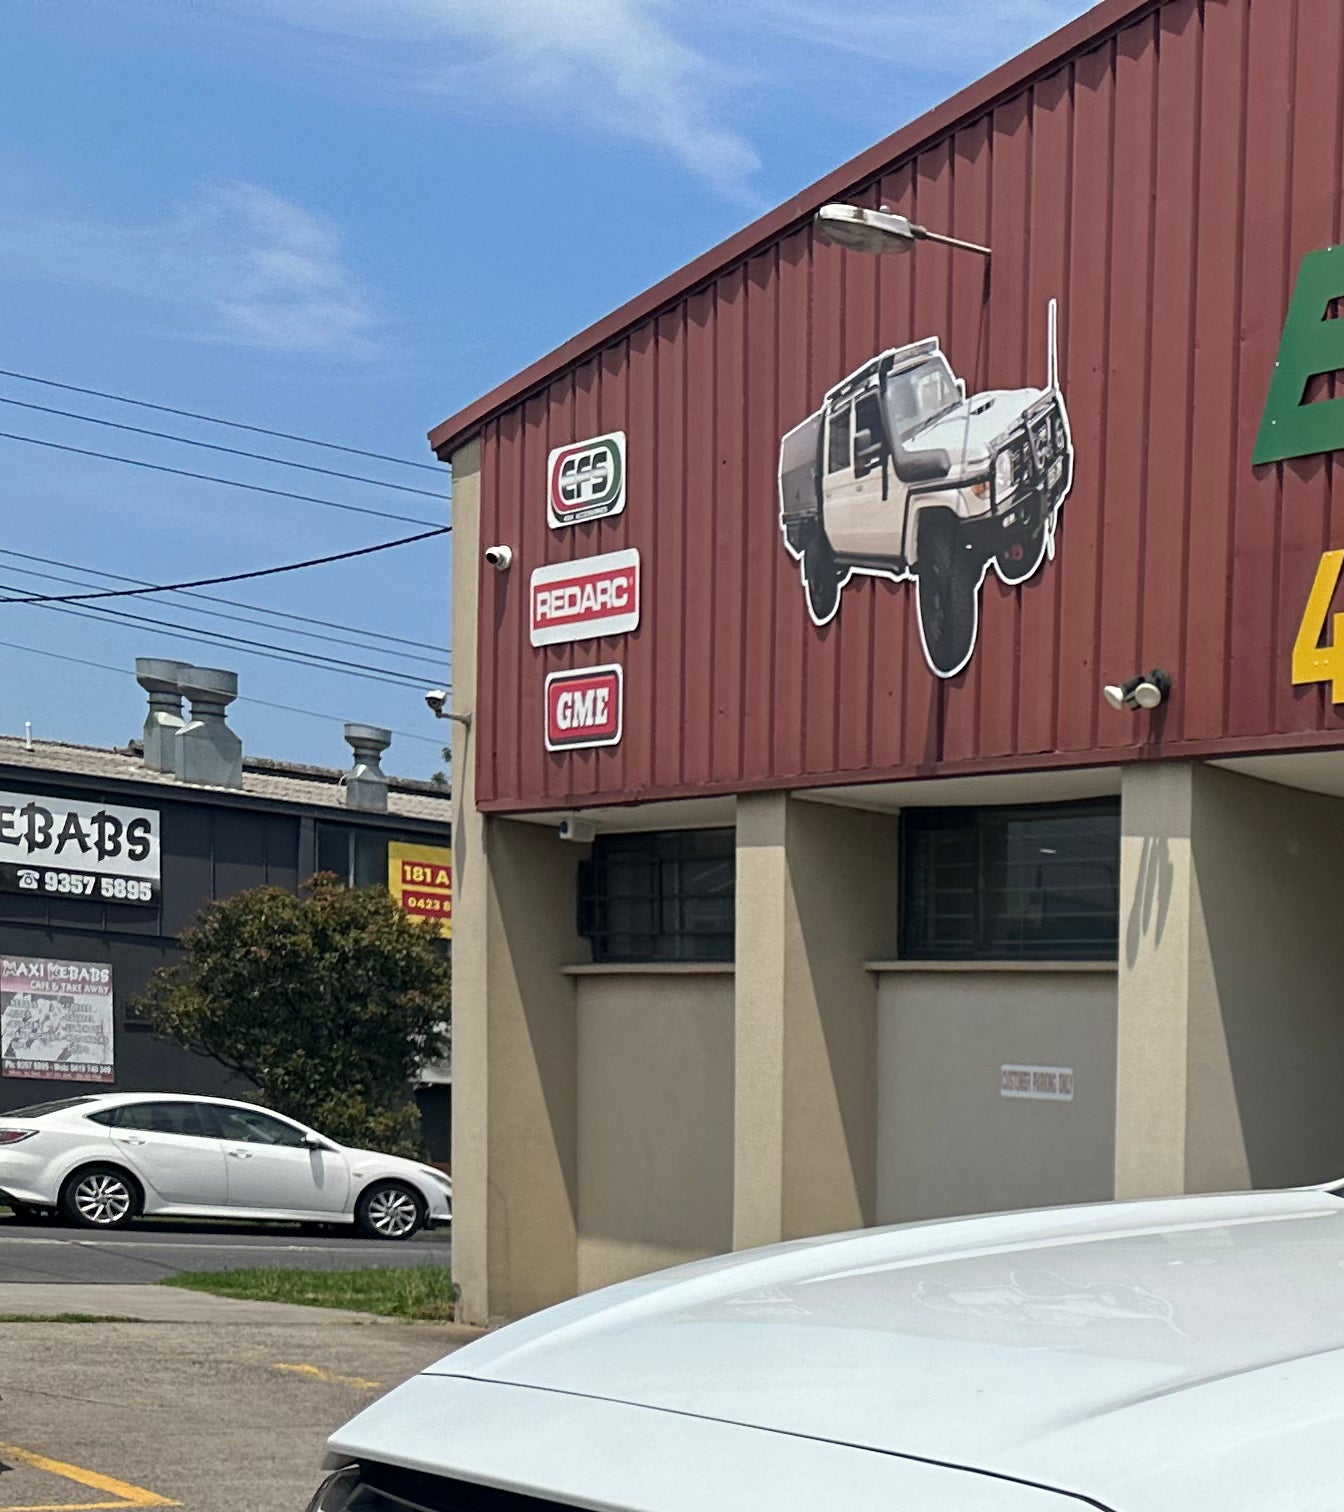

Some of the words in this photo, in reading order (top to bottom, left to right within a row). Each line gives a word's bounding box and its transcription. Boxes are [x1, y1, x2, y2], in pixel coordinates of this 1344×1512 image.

[562, 451, 608, 501] EFS
[536, 576, 629, 622] REDARC
[556, 687, 610, 730] GME
[0, 801, 152, 862] EBABS
[44, 871, 96, 895] 9357
[101, 877, 152, 901] 5895
[403, 865, 432, 883] 181
[408, 896, 440, 911] 0423
[2, 960, 44, 977] MAXI
[47, 962, 110, 983] KEBABS
[84, 984, 109, 997] AWAY
